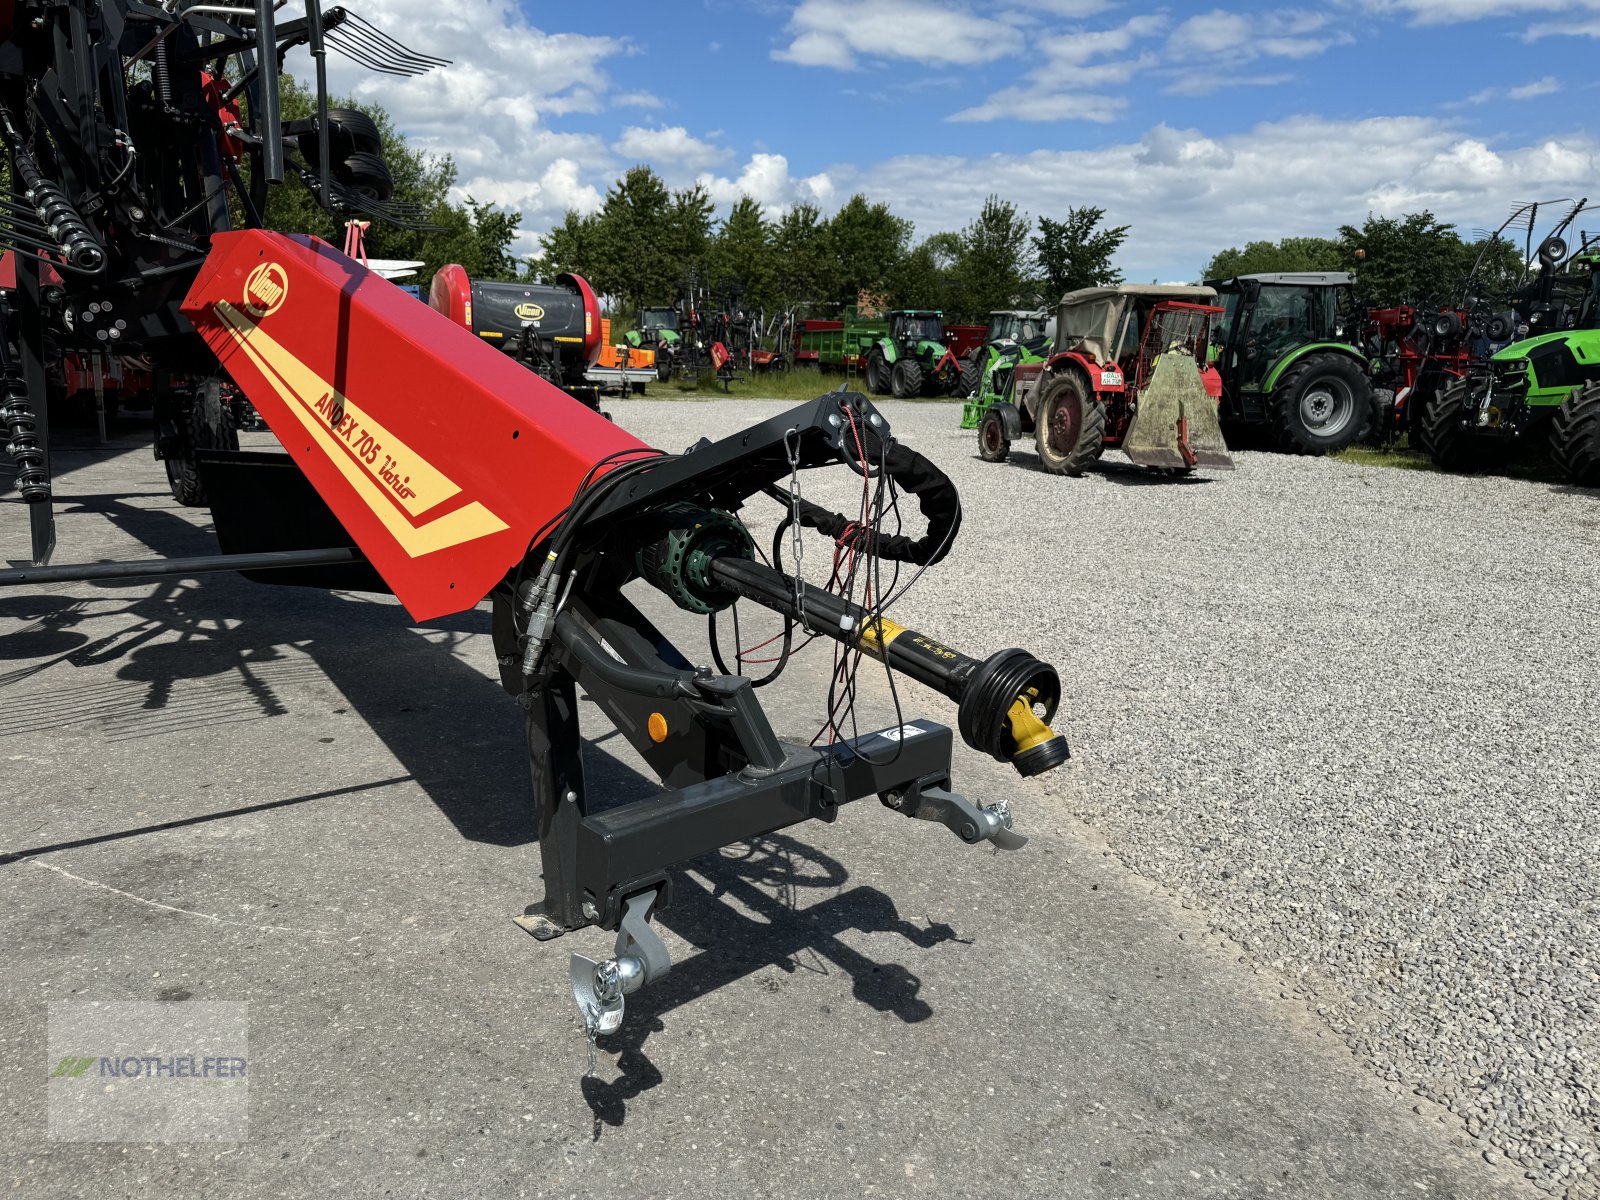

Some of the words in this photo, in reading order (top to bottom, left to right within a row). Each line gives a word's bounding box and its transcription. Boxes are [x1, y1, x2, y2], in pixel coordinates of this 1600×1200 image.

[249, 263, 283, 306] Vicon
[518, 304, 541, 317] Vicon
[314, 392, 359, 442] ANDEX
[352, 429, 382, 464] 705
[378, 454, 416, 499] Vario
